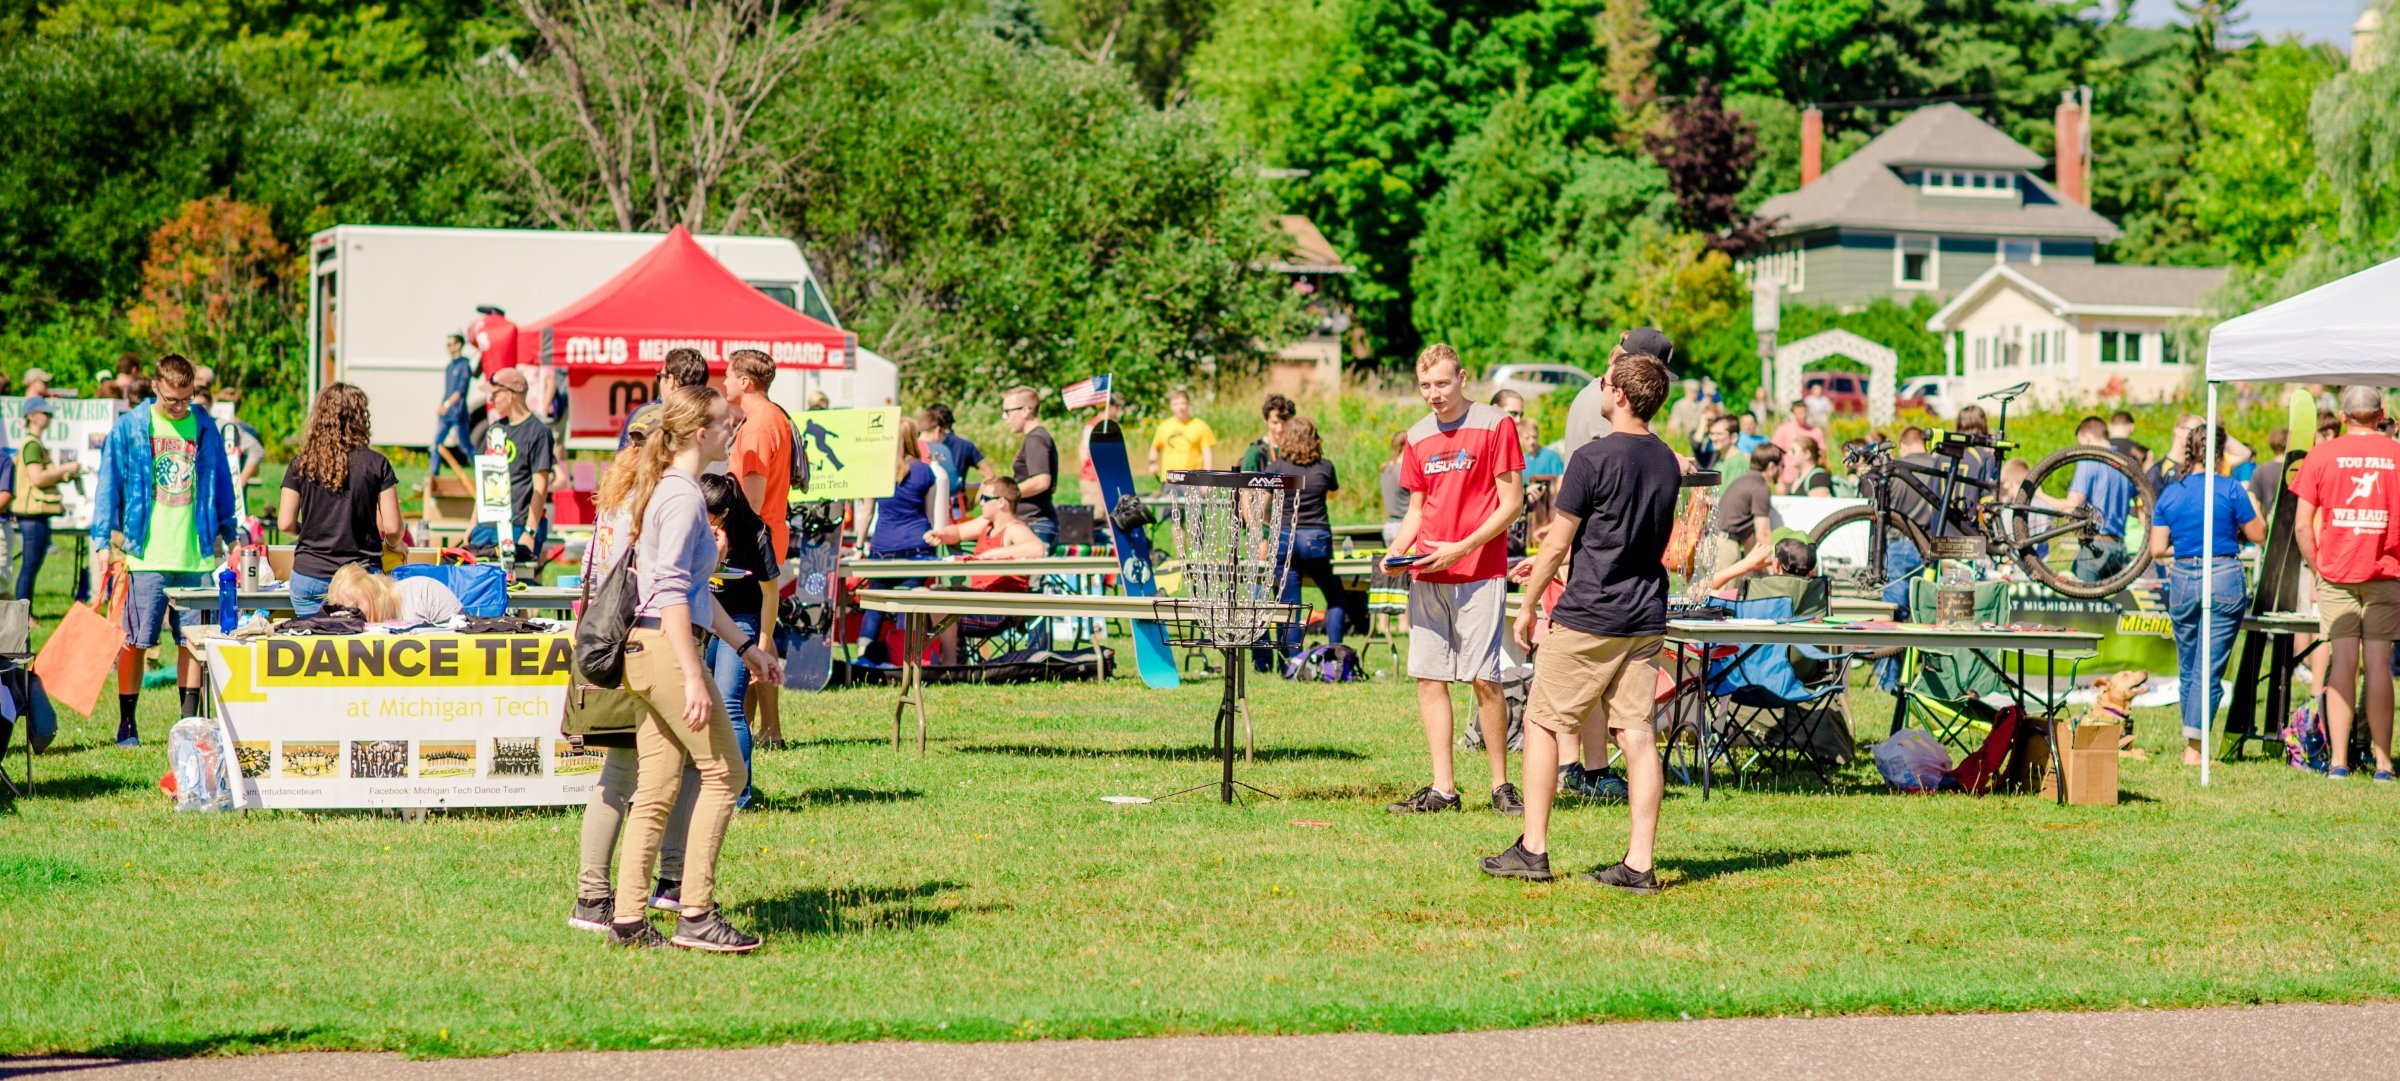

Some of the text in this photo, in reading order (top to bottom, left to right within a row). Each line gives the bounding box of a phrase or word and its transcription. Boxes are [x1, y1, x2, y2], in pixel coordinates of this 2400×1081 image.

[566, 337, 628, 364] MUB
[772, 341, 825, 364] BOARD
[9, 421, 70, 441] GLD
[2336, 456, 2396, 470] YOU FALL
[828, 480, 849, 489] Tech
[1248, 476, 1283, 485] MVP
[2332, 508, 2356, 521] WE
[248, 566, 257, 578] S
[2023, 600, 2084, 612] MICHIGAN
[2120, 613, 2174, 637] Michig
[267, 638, 573, 678] DANCE TEA
[346, 695, 549, 722] at Michigan Tech
[262, 787, 322, 796] mtudanceteam
[369, 786, 410, 795] Facebook:
[413, 786, 450, 796] Michigan
[452, 786, 472, 794] Tech
[474, 786, 501, 794] Dance
[562, 785, 586, 793] Email:
